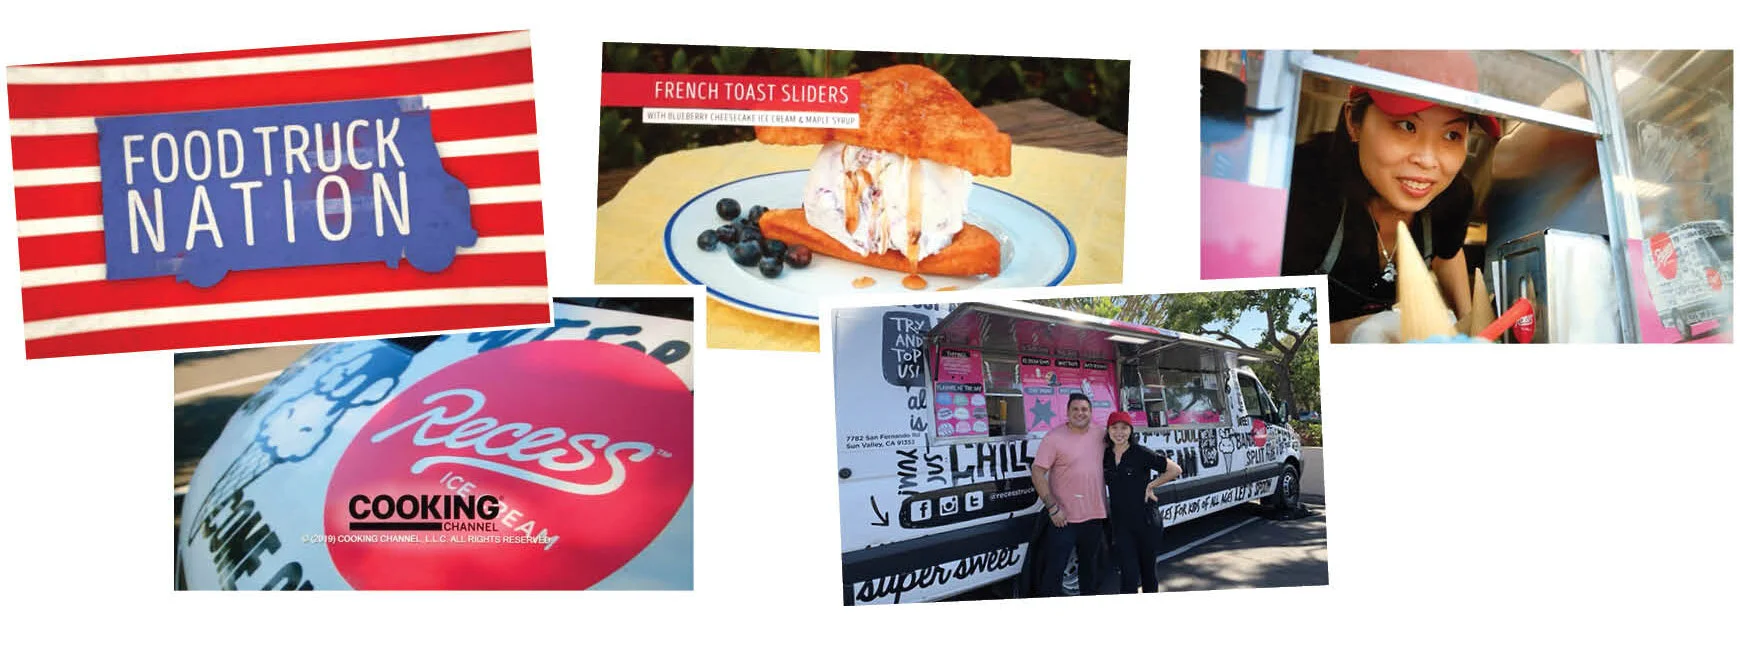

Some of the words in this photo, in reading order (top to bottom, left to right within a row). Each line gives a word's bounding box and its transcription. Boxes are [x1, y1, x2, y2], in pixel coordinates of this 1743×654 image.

[122, 127, 245, 184] FOOD
[253, 117, 404, 176] TRUCK
[127, 171, 411, 254] NATION
[889, 316, 926, 333] TRY
[891, 348, 922, 363] TOP
[895, 335, 924, 349] AND
[897, 364, 921, 379] US!
[372, 388, 654, 496] Recess
[440, 471, 476, 498] ICE
[856, 565, 951, 605] super
[953, 548, 1021, 580] sweet
